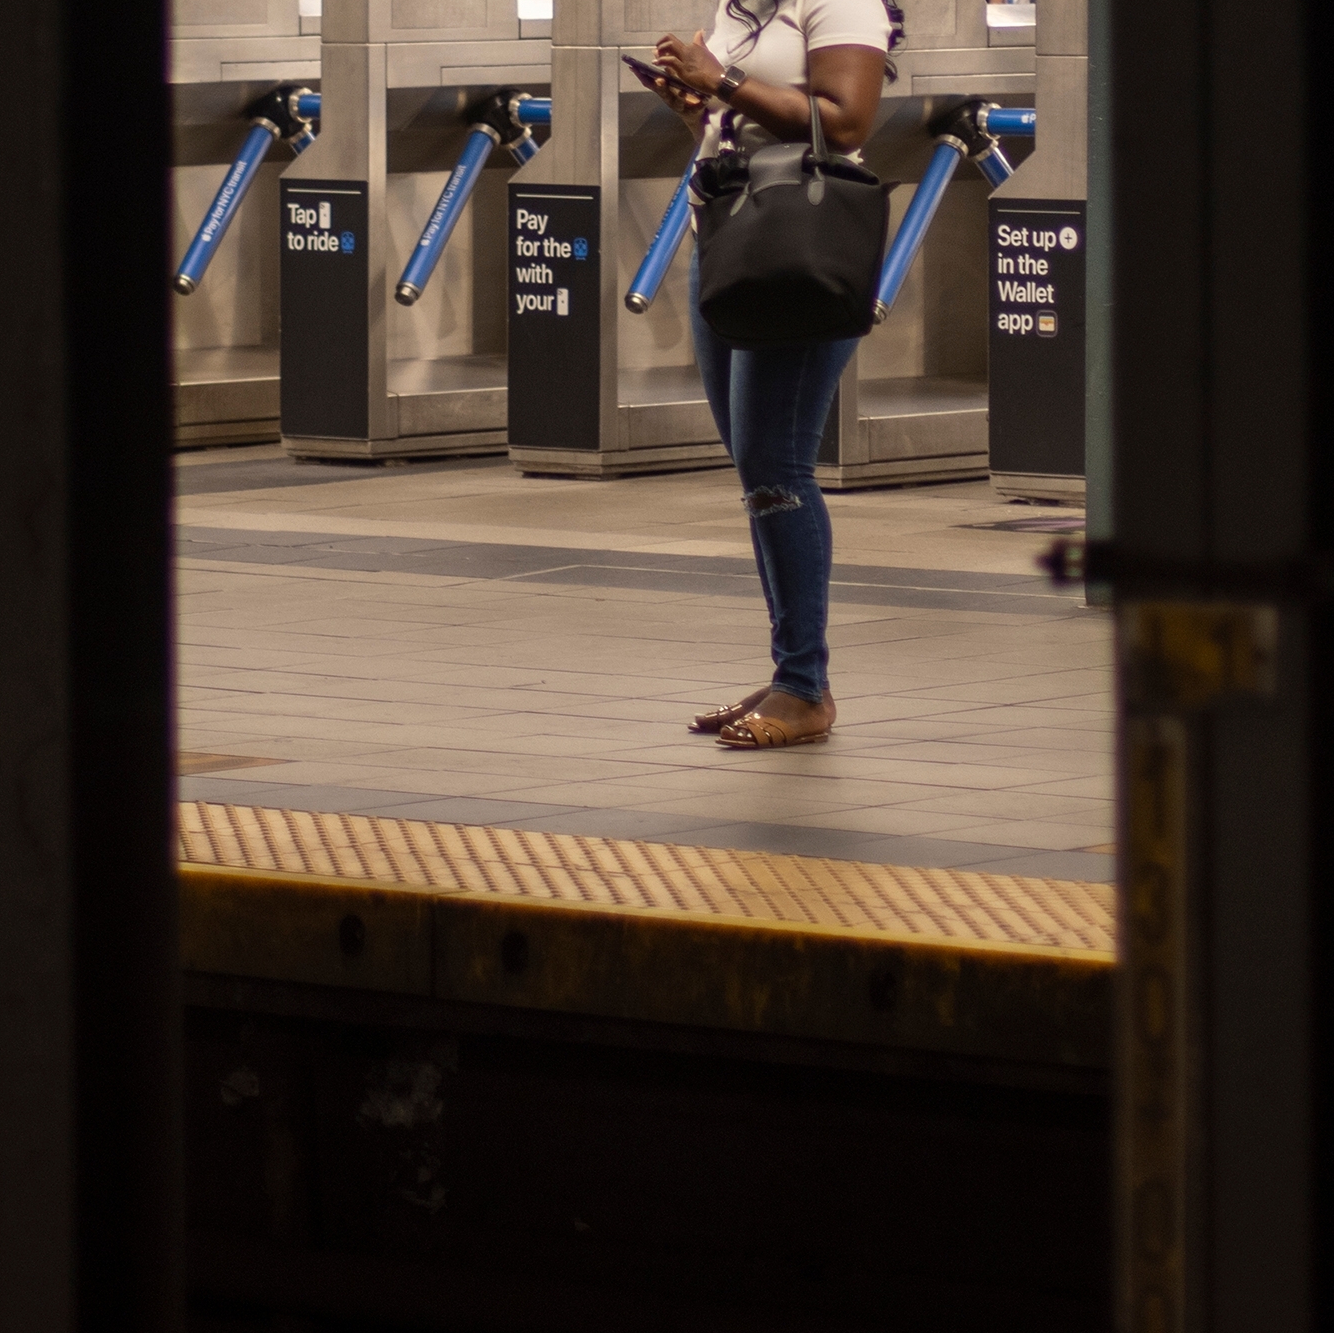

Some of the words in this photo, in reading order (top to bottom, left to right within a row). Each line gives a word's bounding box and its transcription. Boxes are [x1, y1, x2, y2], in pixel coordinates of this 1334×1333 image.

[217, 187, 234, 207] NYC
[437, 191, 453, 211] NYC
[287, 203, 317, 228] Tap
[516, 209, 548, 235] Pay
[287, 232, 305, 250] to
[307, 230, 339, 252] ride
[516, 236, 540, 257] for
[543, 237, 572, 258] the
[997, 224, 1029, 246] Set
[1032, 230, 1057, 252] up
[516, 262, 553, 284] with
[998, 252, 1014, 274] in
[1017, 254, 1048, 275] the
[997, 281, 1054, 303] Wallet
[516, 294, 554, 314] your
[997, 313, 1033, 335] app
